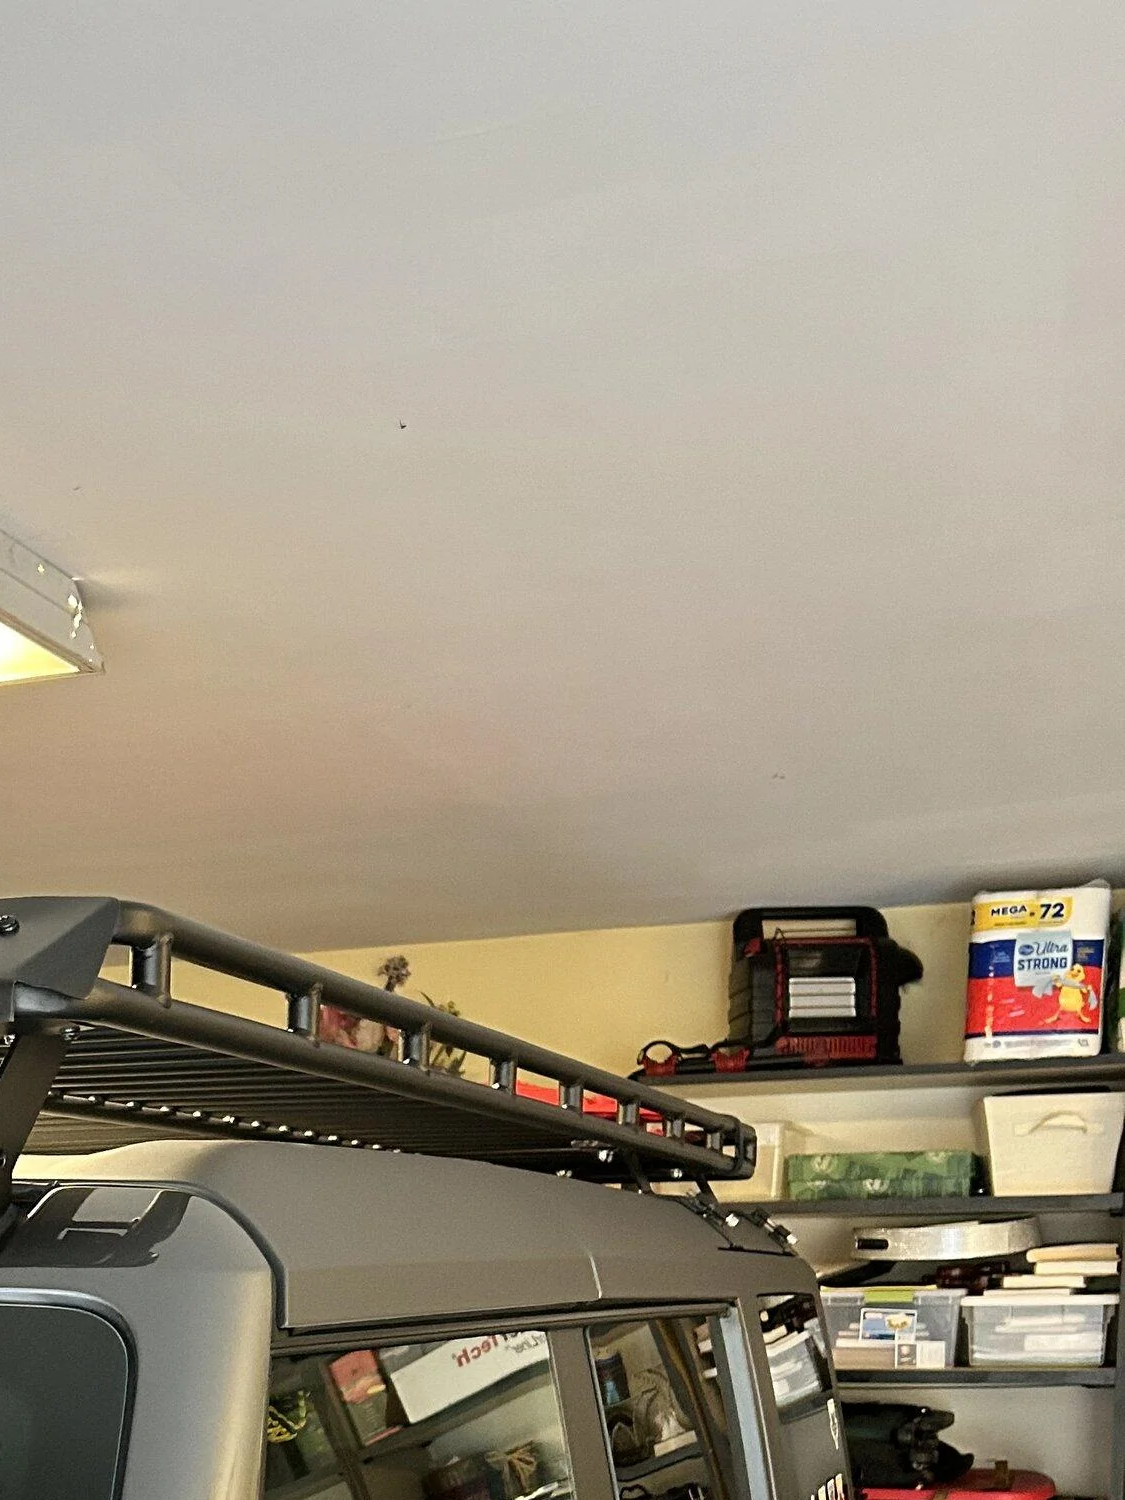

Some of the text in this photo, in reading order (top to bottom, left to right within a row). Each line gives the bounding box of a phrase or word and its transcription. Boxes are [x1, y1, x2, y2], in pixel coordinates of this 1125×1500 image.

[990, 902, 1065, 919] MEGA 72
[1034, 941, 1069, 955] Ultra
[1018, 958, 1067, 971] STRONG
